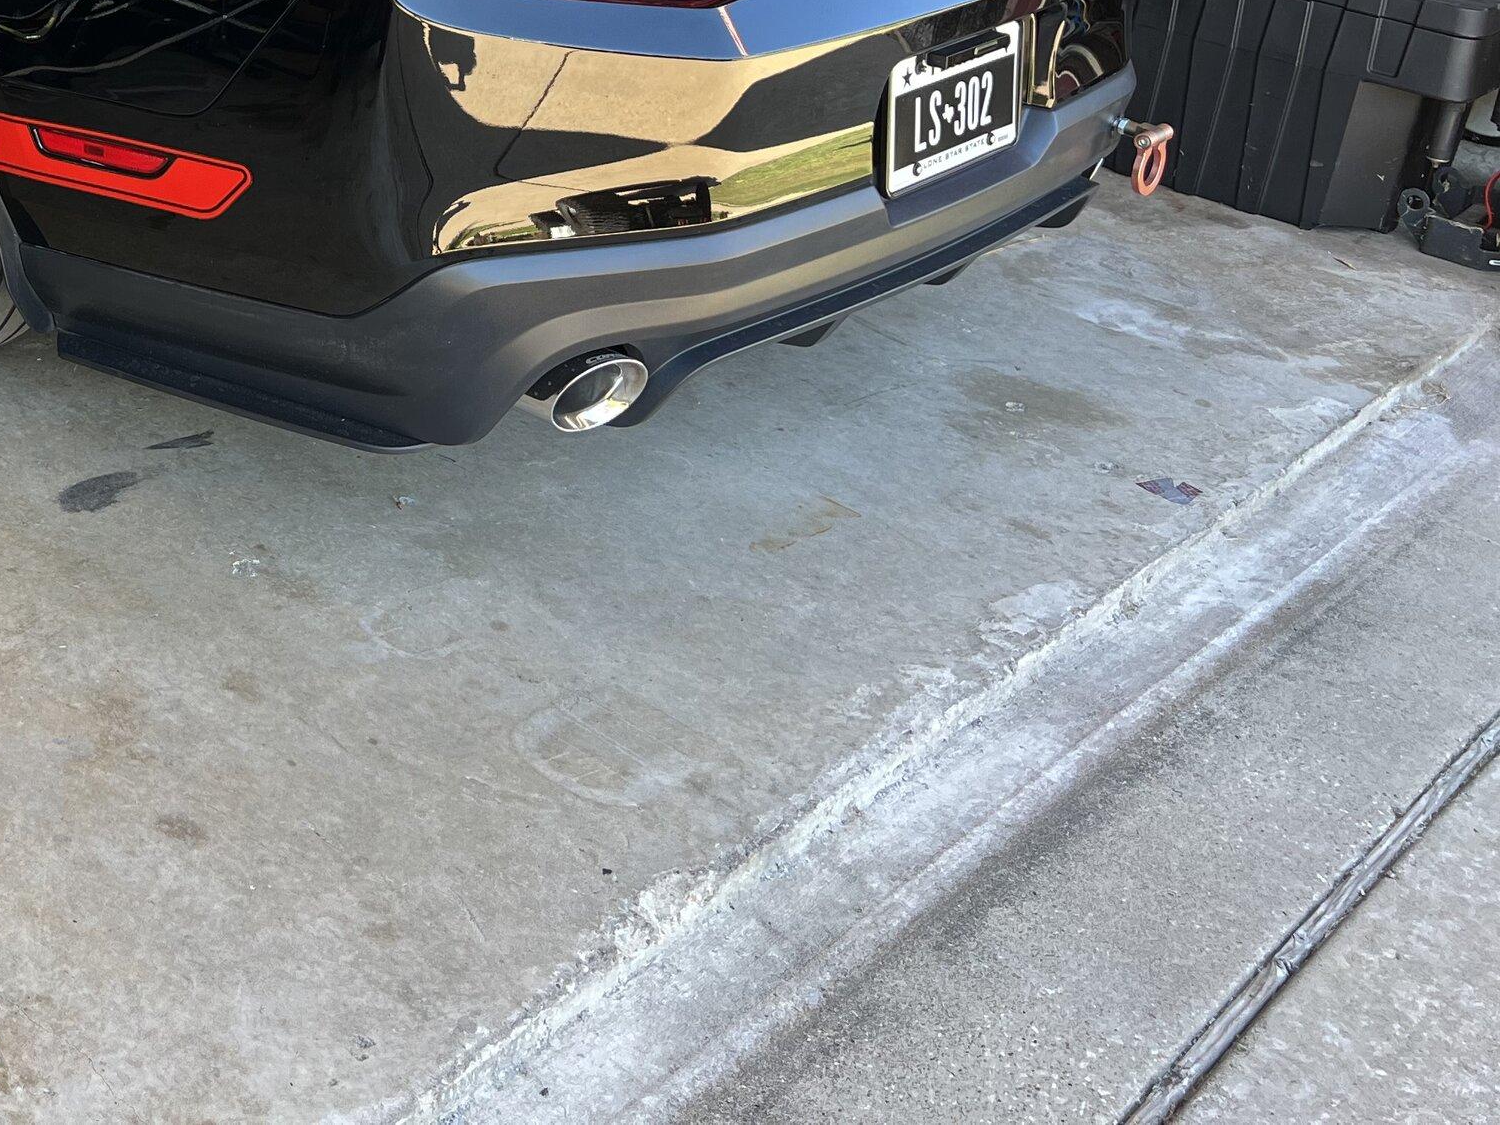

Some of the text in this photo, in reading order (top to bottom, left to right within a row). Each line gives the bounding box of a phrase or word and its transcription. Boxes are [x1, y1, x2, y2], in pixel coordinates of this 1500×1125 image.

[914, 71, 994, 153] LS 302
[923, 138, 985, 169] LONE STAR STATE
